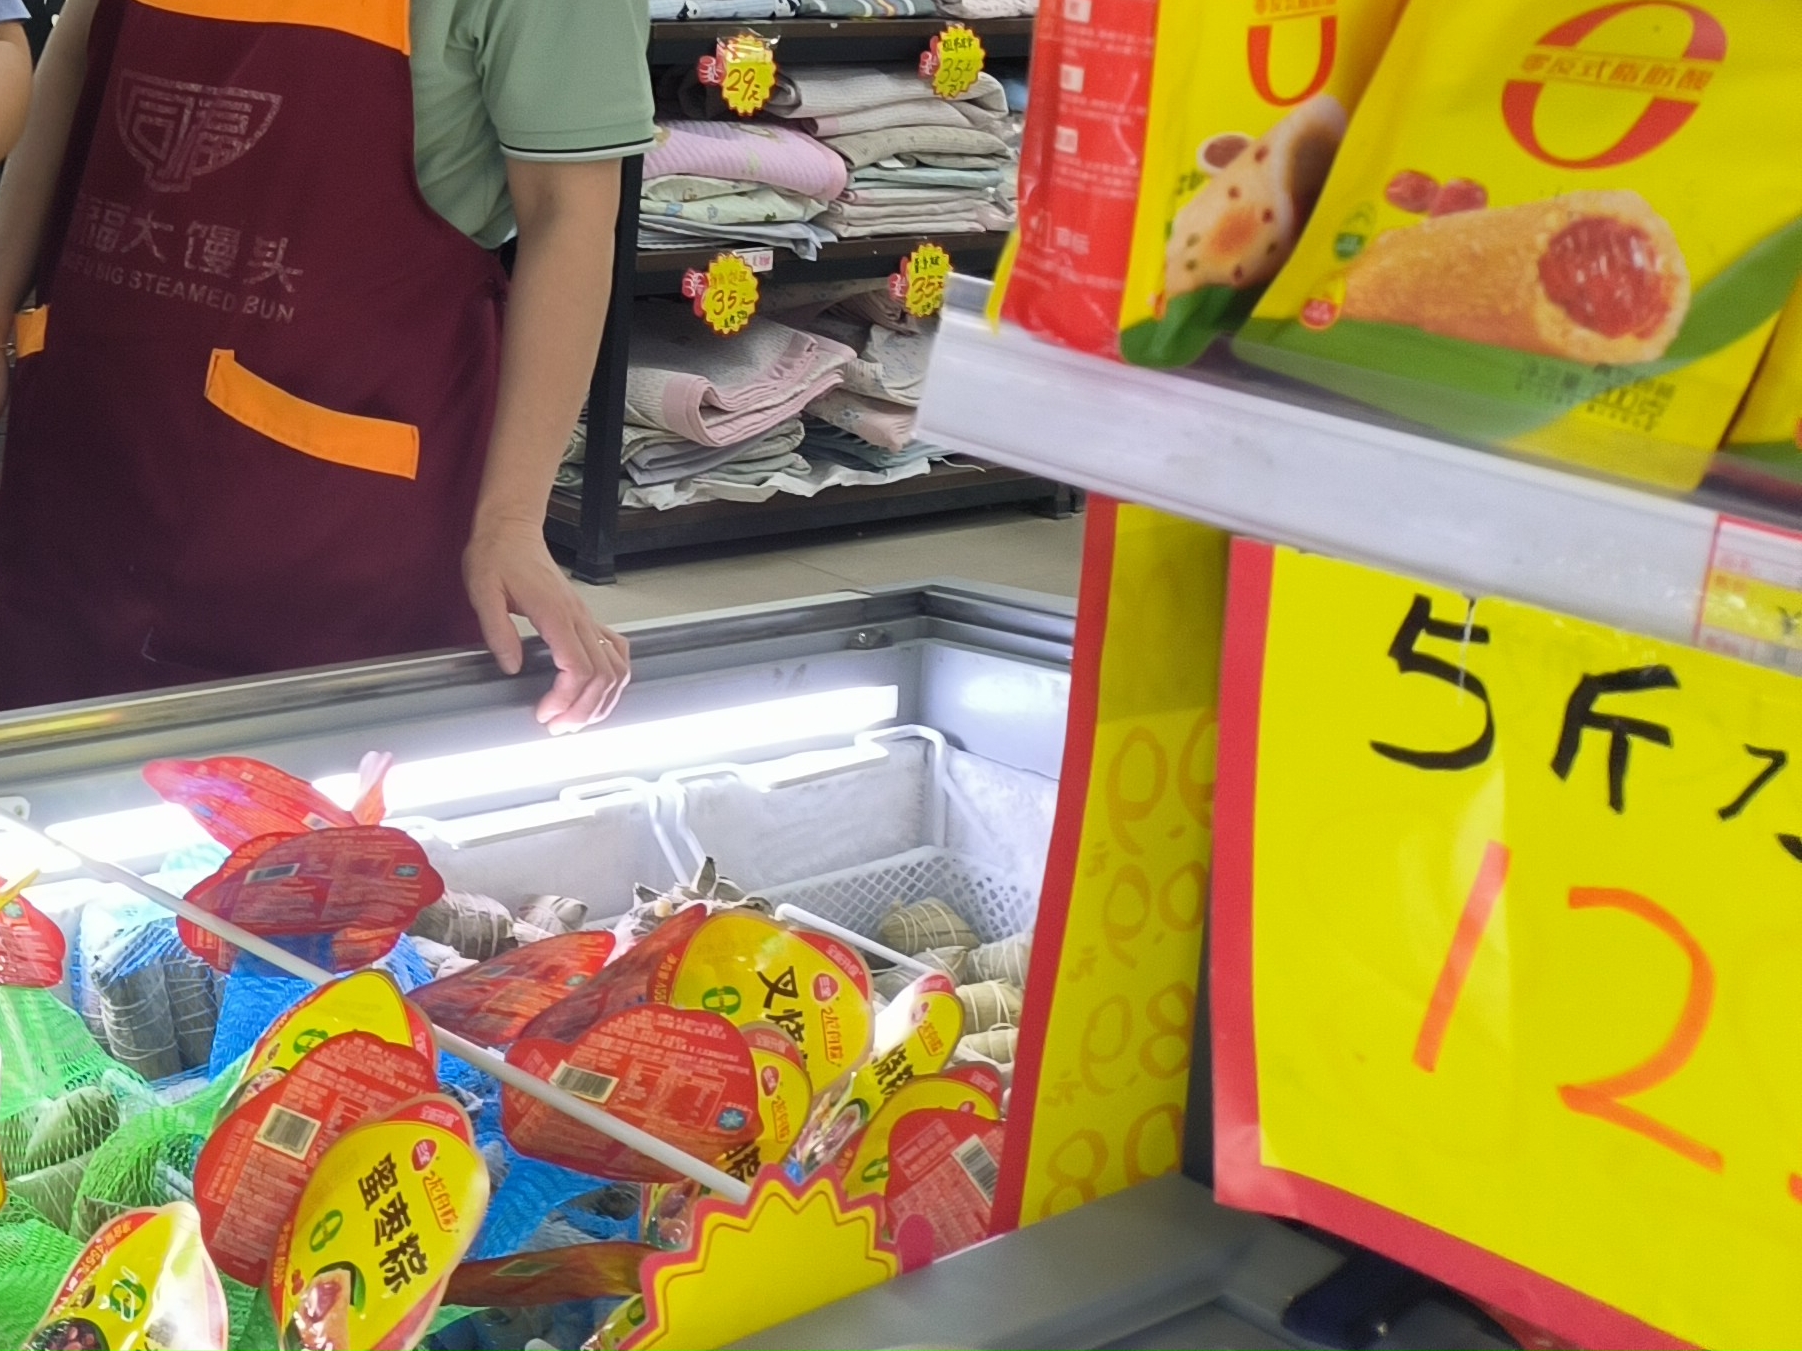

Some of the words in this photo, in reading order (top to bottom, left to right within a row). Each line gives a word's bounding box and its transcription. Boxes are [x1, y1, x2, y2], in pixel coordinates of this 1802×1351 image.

[128, 269, 240, 313] STEAMED
[242, 294, 295, 324] BUN
[757, 965, 807, 1060] 叉烧
[357, 1151, 429, 1295] 蜜枣粽
